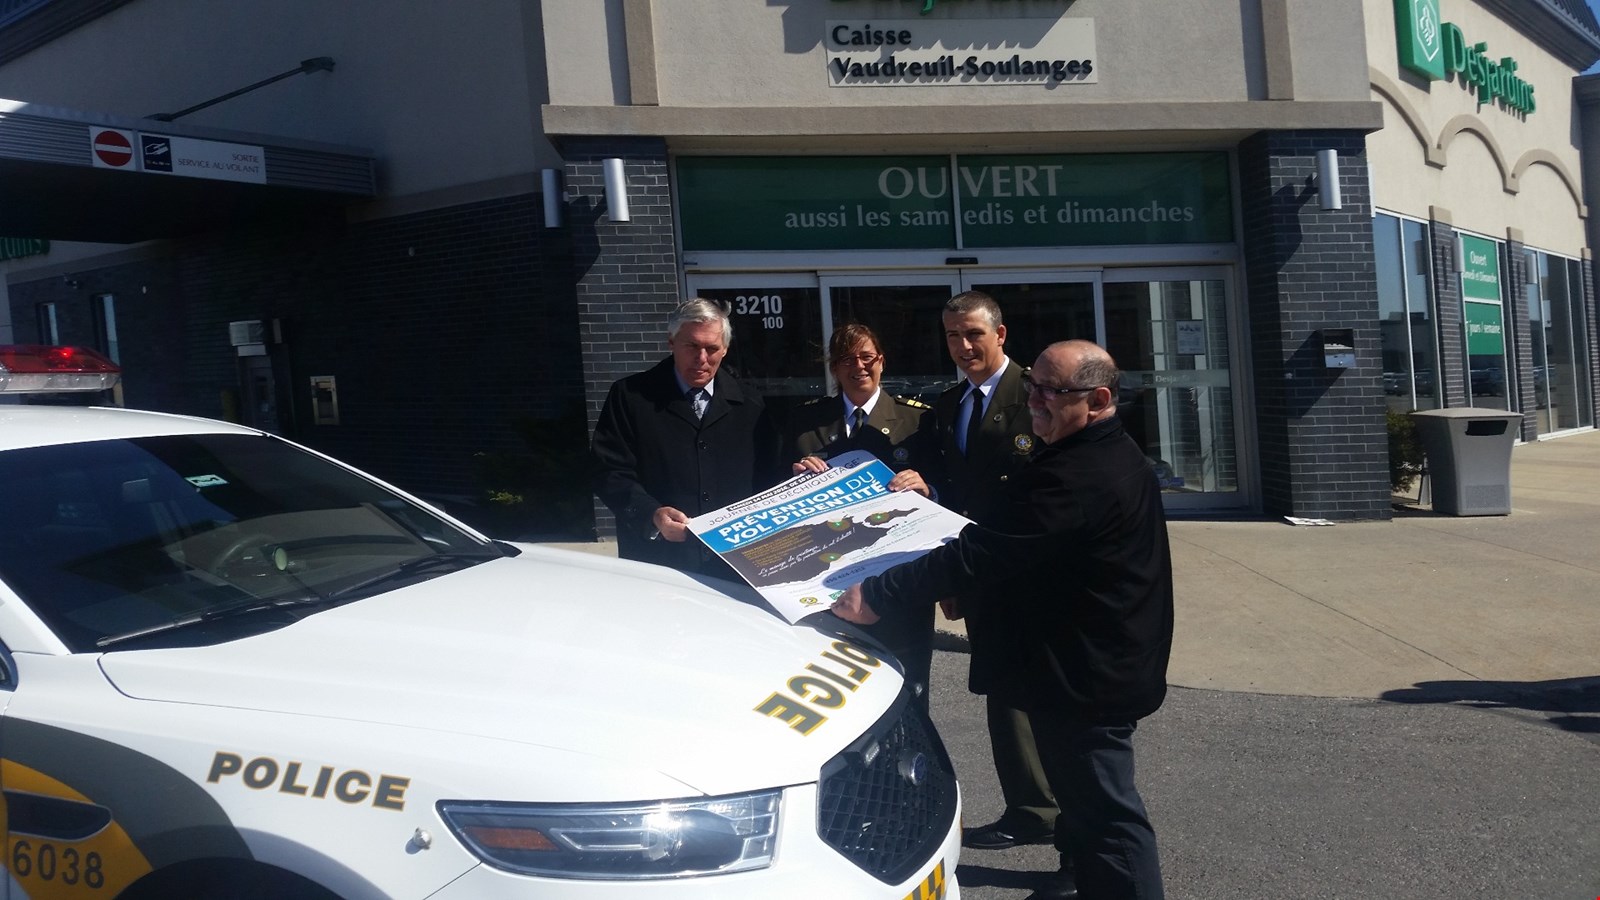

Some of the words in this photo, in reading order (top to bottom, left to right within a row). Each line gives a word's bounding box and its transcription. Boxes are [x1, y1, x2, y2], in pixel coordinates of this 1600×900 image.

[832, 24, 912, 46] Caisse
[834, 55, 1093, 80] Vaudreuil-Soulanges
[1441, 22, 1536, 114] Desjardins
[178, 158, 210, 168] SERVICE
[212, 162, 224, 170] AU
[226, 163, 259, 173] VOLANT
[232, 153, 259, 163] SORTIE
[878, 165, 1063, 199] OUVERT
[785, 205, 847, 228] aussi
[856, 205, 891, 226] les
[1023, 204, 1048, 224] et
[1057, 200, 1194, 223] dimanches
[1470, 250, 1487, 266] Ouvert
[736, 295, 782, 314] 3210
[762, 316, 784, 329] 100
[1469, 320, 1481, 336] jours
[1484, 321, 1501, 334] semaine
[709, 504, 760, 526] JOURNÉE
[762, 498, 778, 510] DE
[719, 486, 847, 537] PRÉVENTION
[845, 471, 875, 491] DU
[725, 524, 772, 544] VOL
[772, 479, 887, 526] D'IDENTITÉ
[206, 751, 411, 811] POLICE
[12, 840, 104, 889] 6038
